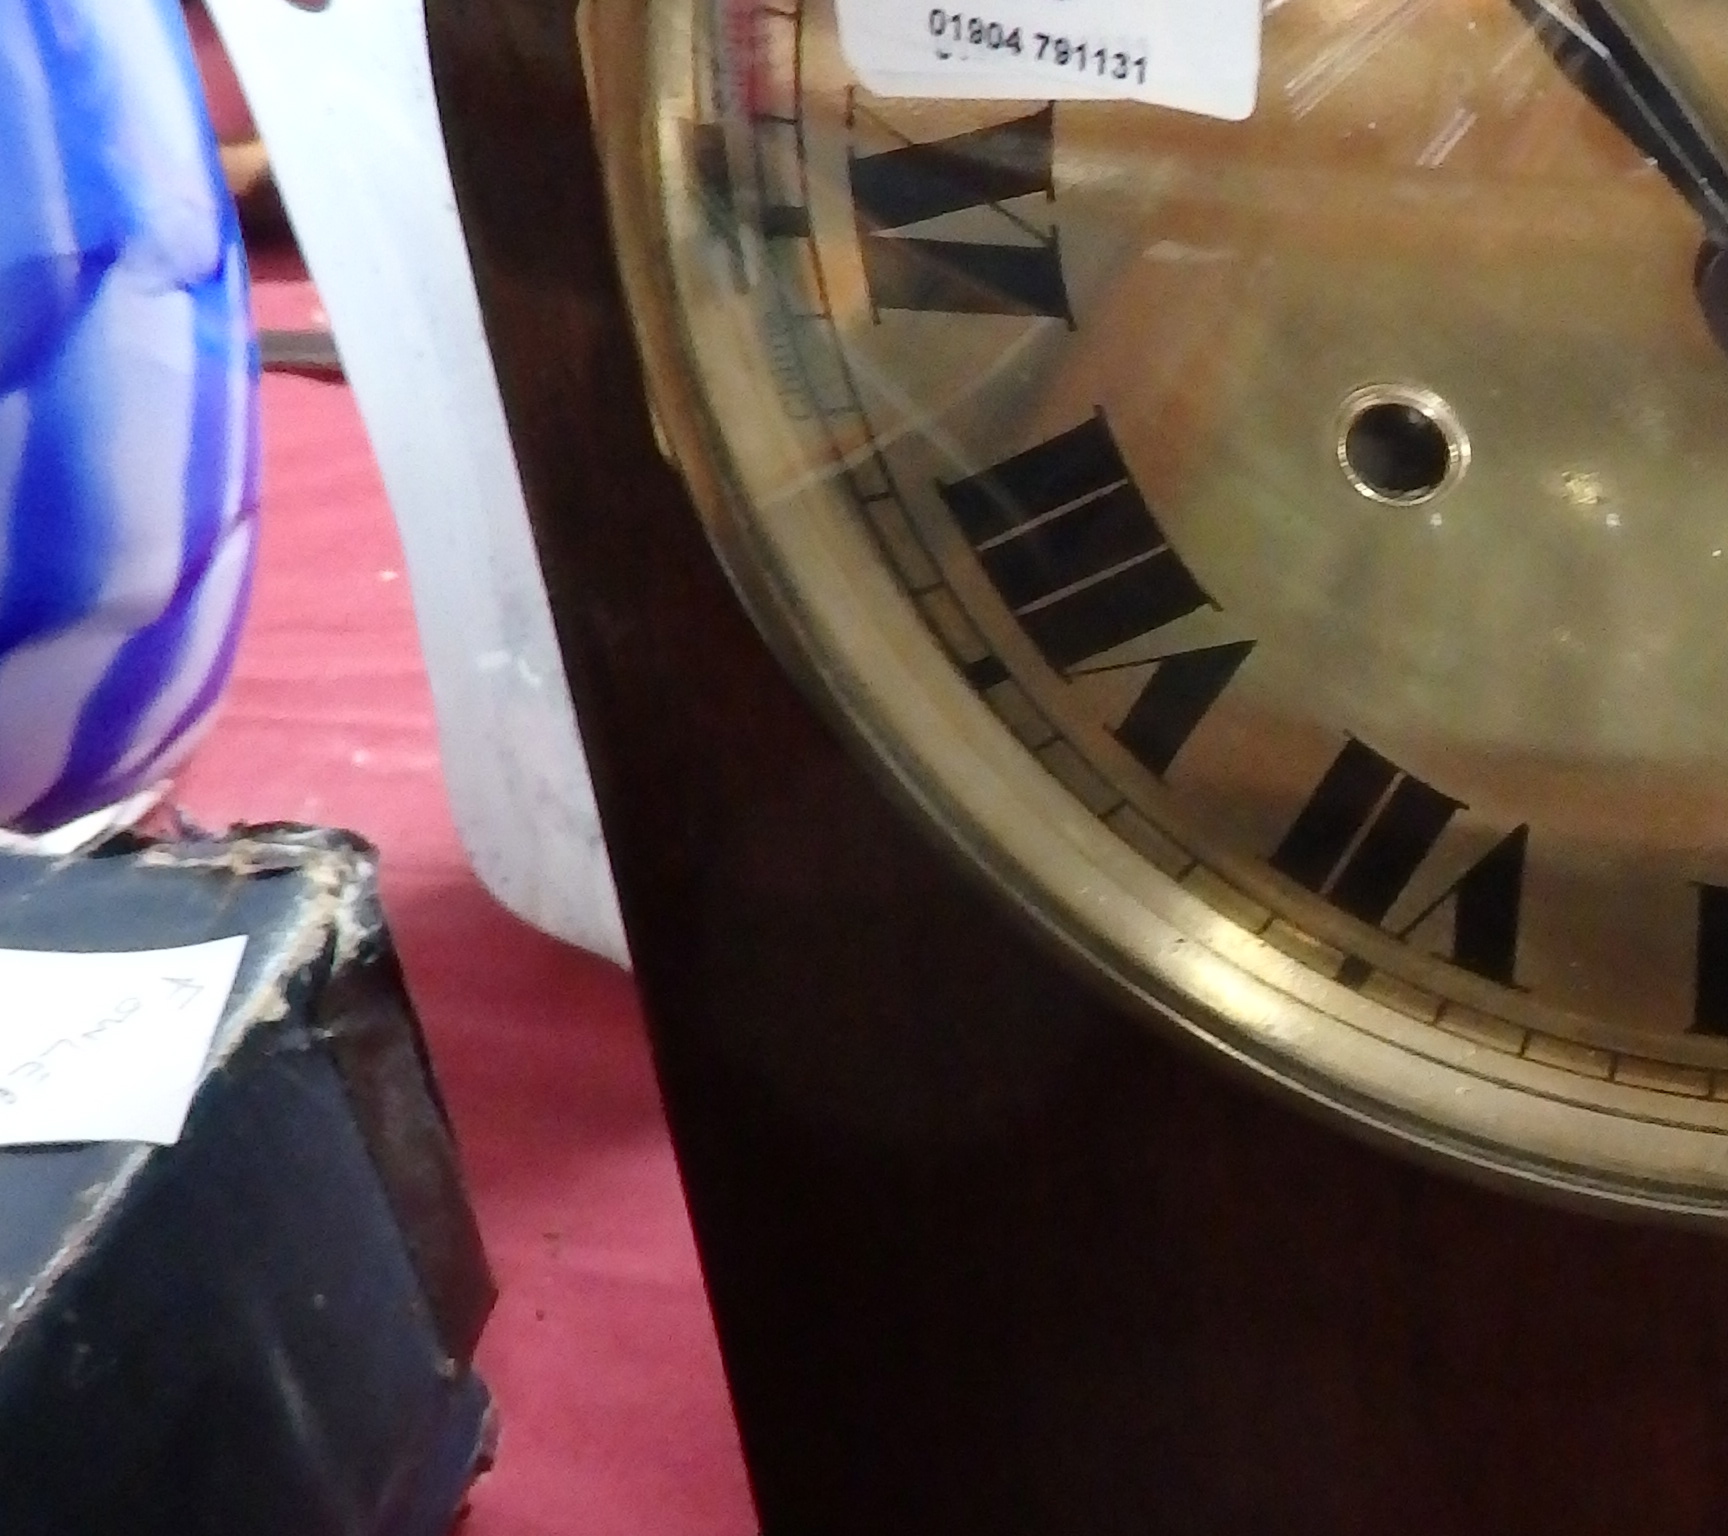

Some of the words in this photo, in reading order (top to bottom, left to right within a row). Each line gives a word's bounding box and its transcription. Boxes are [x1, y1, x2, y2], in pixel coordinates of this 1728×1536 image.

[928, 8, 1022, 56] 01904
[1033, 32, 1148, 85] 791131
[936, 404, 1256, 788] VIII
[1256, 730, 1531, 992] VII
